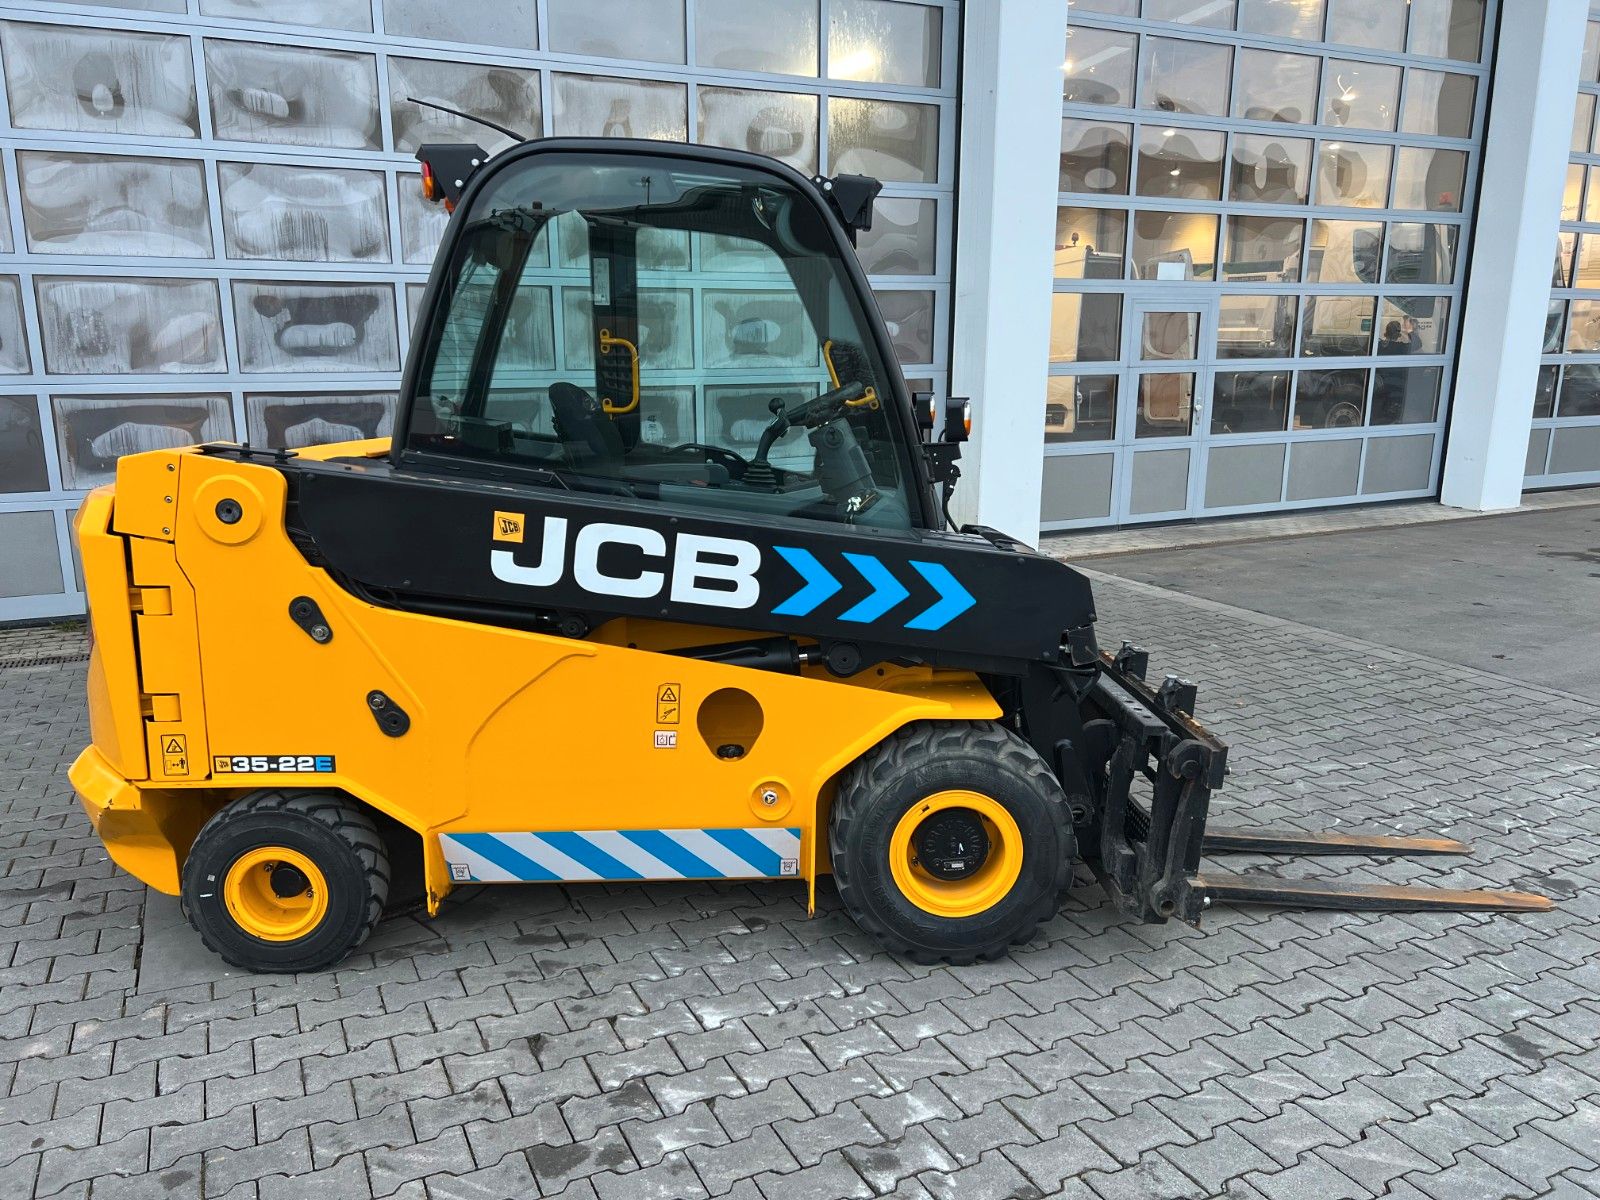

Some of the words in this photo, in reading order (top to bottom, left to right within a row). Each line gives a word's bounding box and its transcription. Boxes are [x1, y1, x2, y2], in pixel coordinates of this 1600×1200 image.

[500, 518, 520, 534] JCB
[491, 516, 762, 609] JCB
[232, 757, 332, 772] 35-22E
